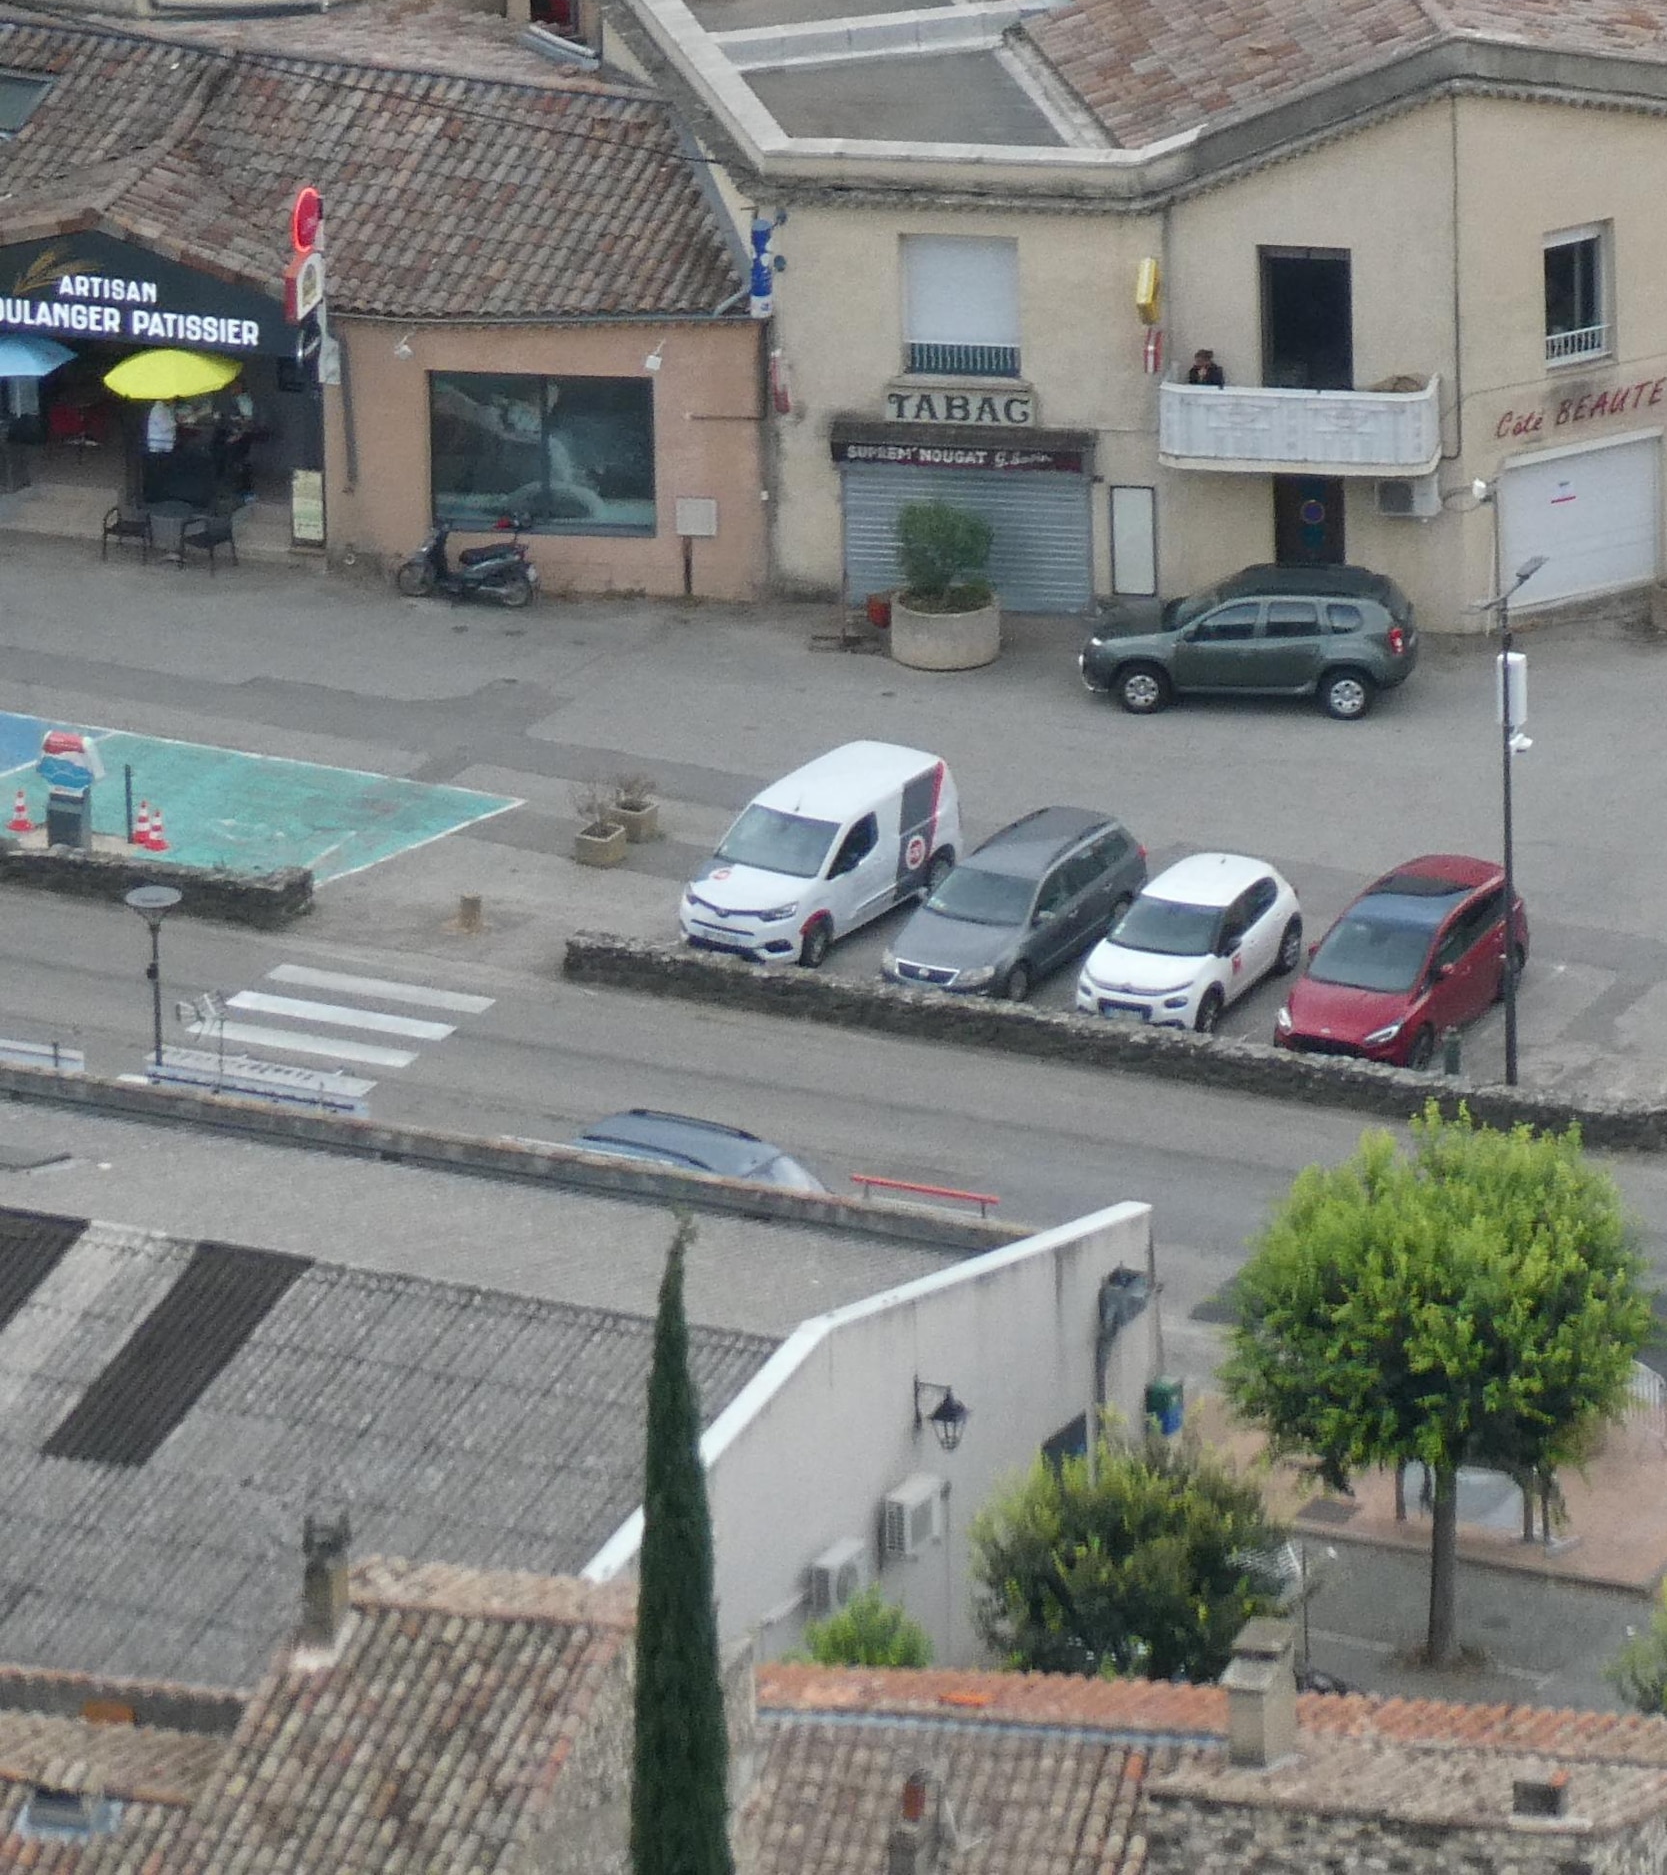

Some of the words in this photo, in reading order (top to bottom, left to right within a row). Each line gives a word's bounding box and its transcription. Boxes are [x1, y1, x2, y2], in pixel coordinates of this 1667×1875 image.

[59, 275, 157, 303] ARTISAN
[132, 310, 259, 346] PATISSIER
[888, 393, 1030, 424] TABAC
[919, 448, 988, 464] NOUGAT
